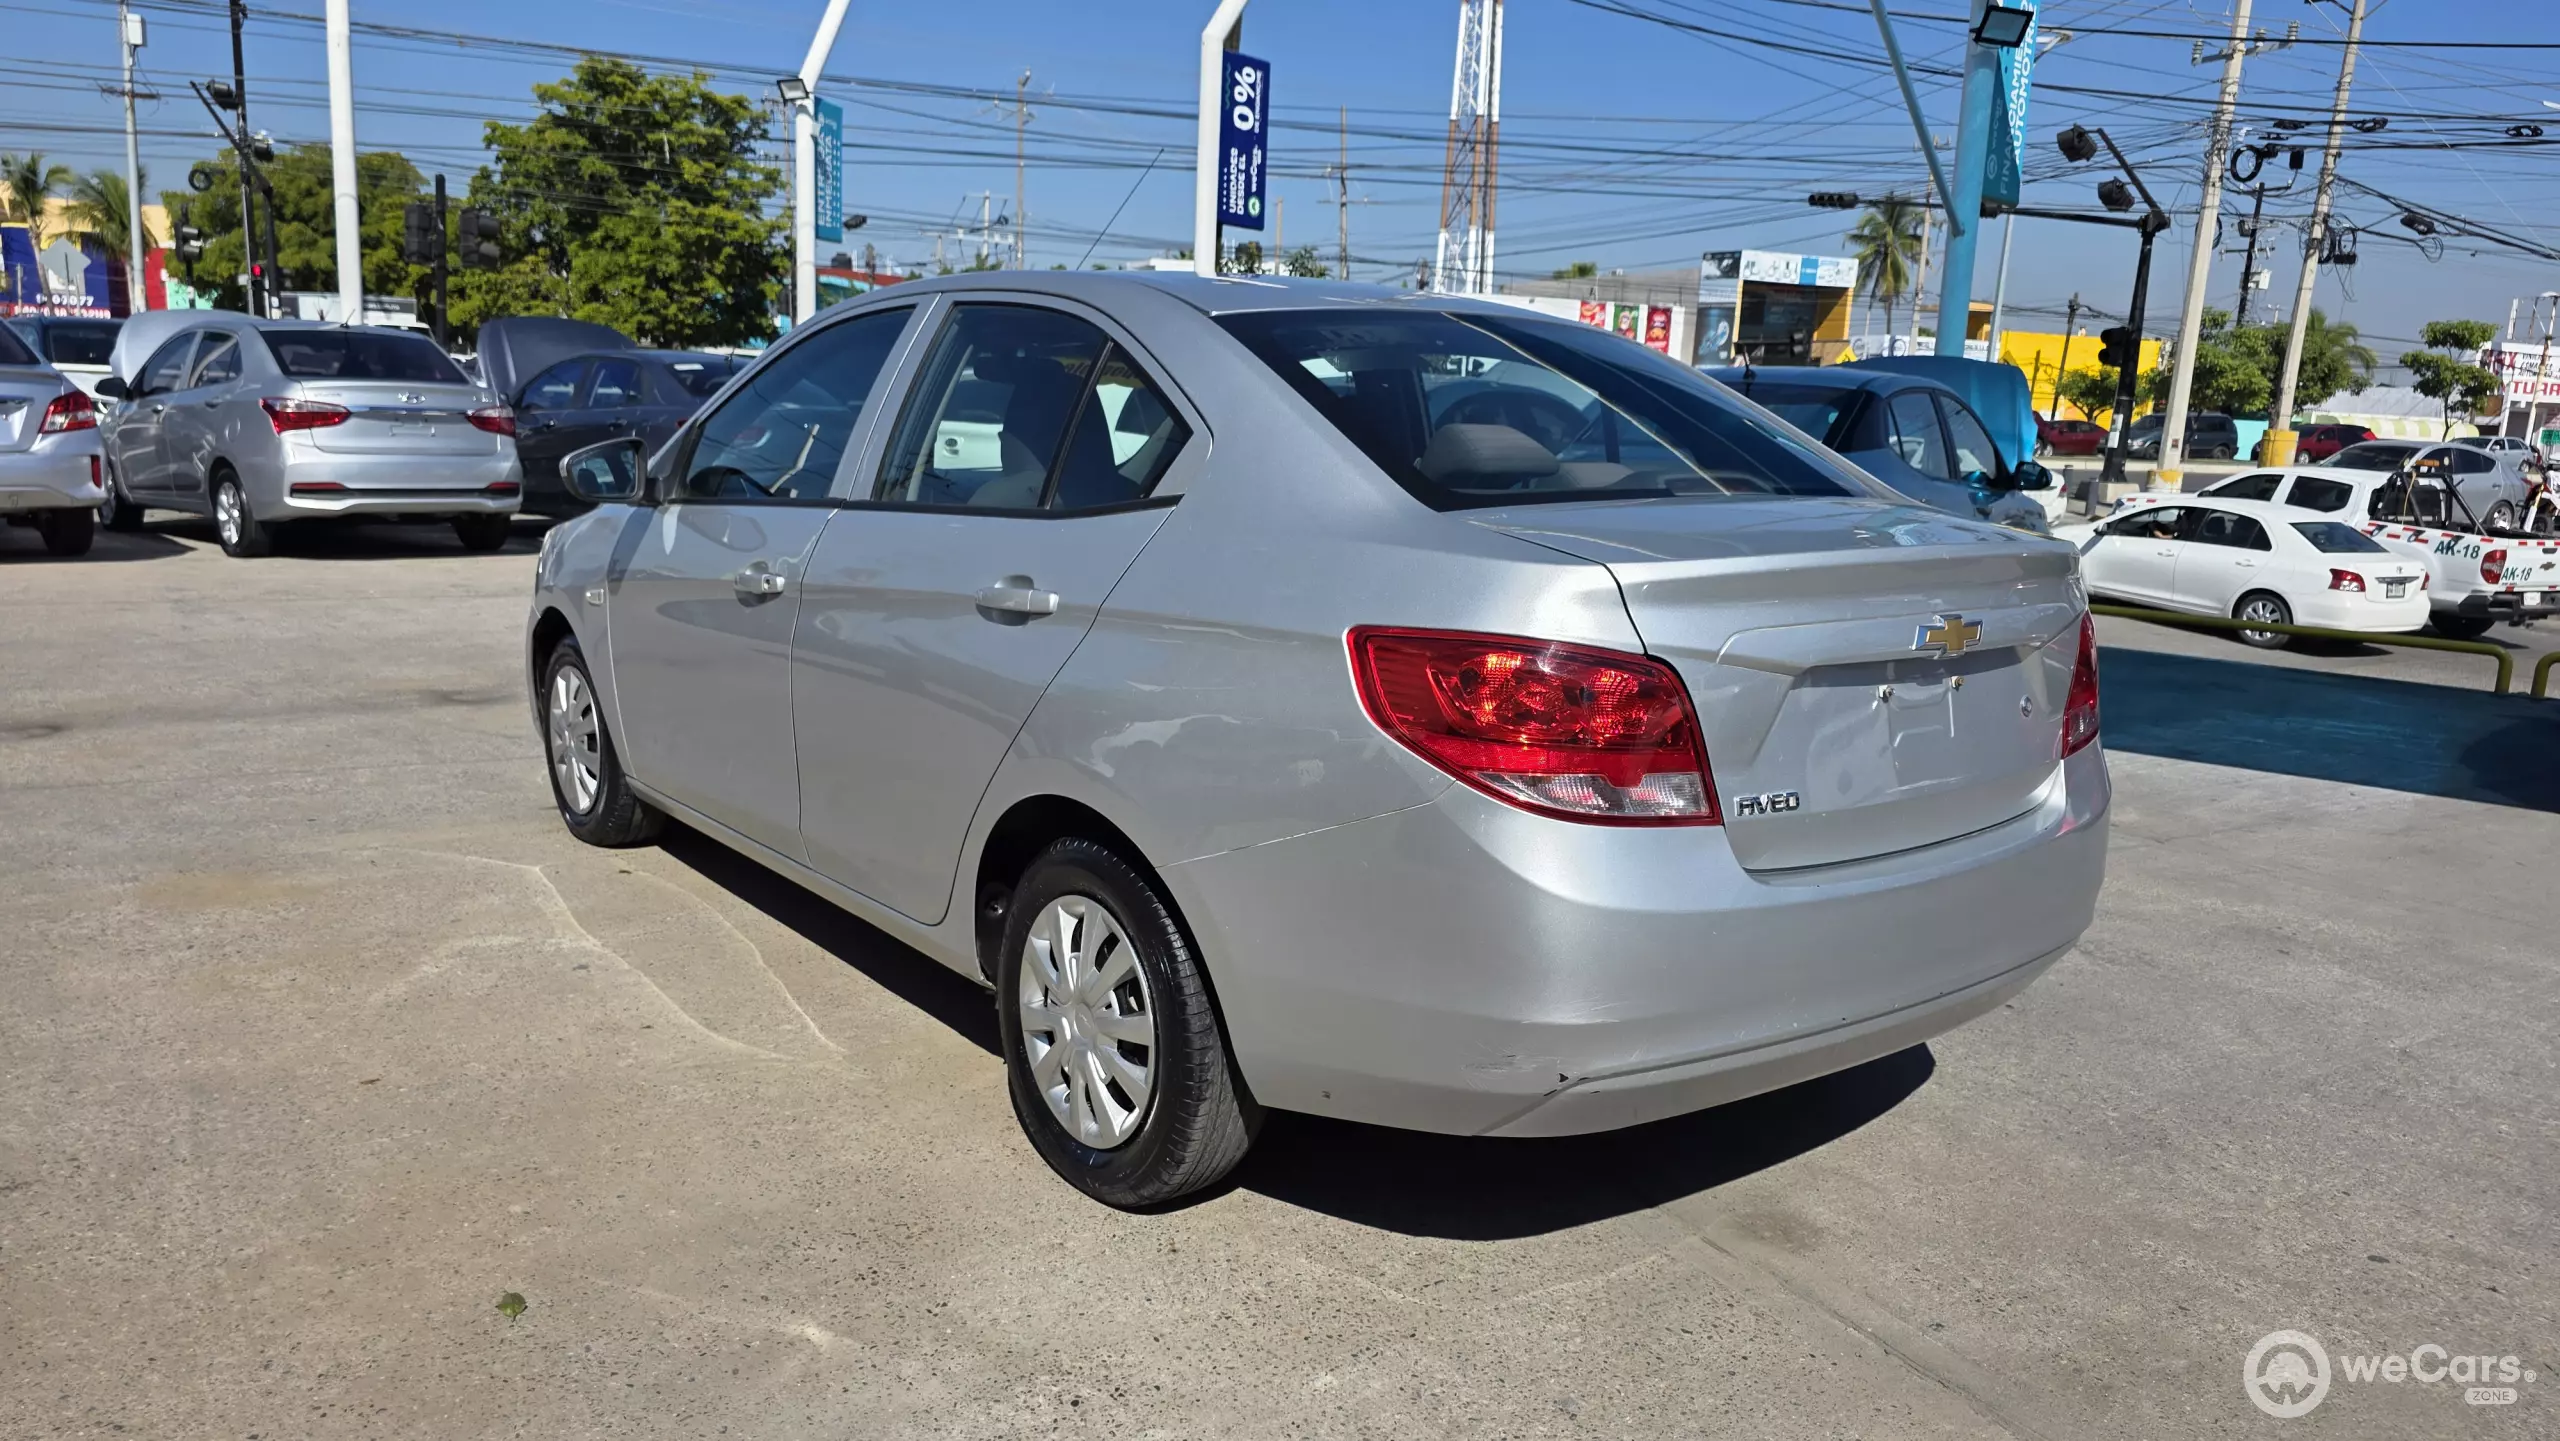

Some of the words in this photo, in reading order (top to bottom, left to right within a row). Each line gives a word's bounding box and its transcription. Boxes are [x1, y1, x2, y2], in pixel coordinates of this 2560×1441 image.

[1233, 66, 1256, 131] 0%
[1238, 154, 1246, 170] EL
[1229, 147, 1239, 214] UNIDADES
[1237, 171, 1246, 215] DESDE
[2434, 540, 2481, 560] AK-18
[2501, 567, 2533, 581] AK-18
[1734, 791, 1800, 817] AVEO
